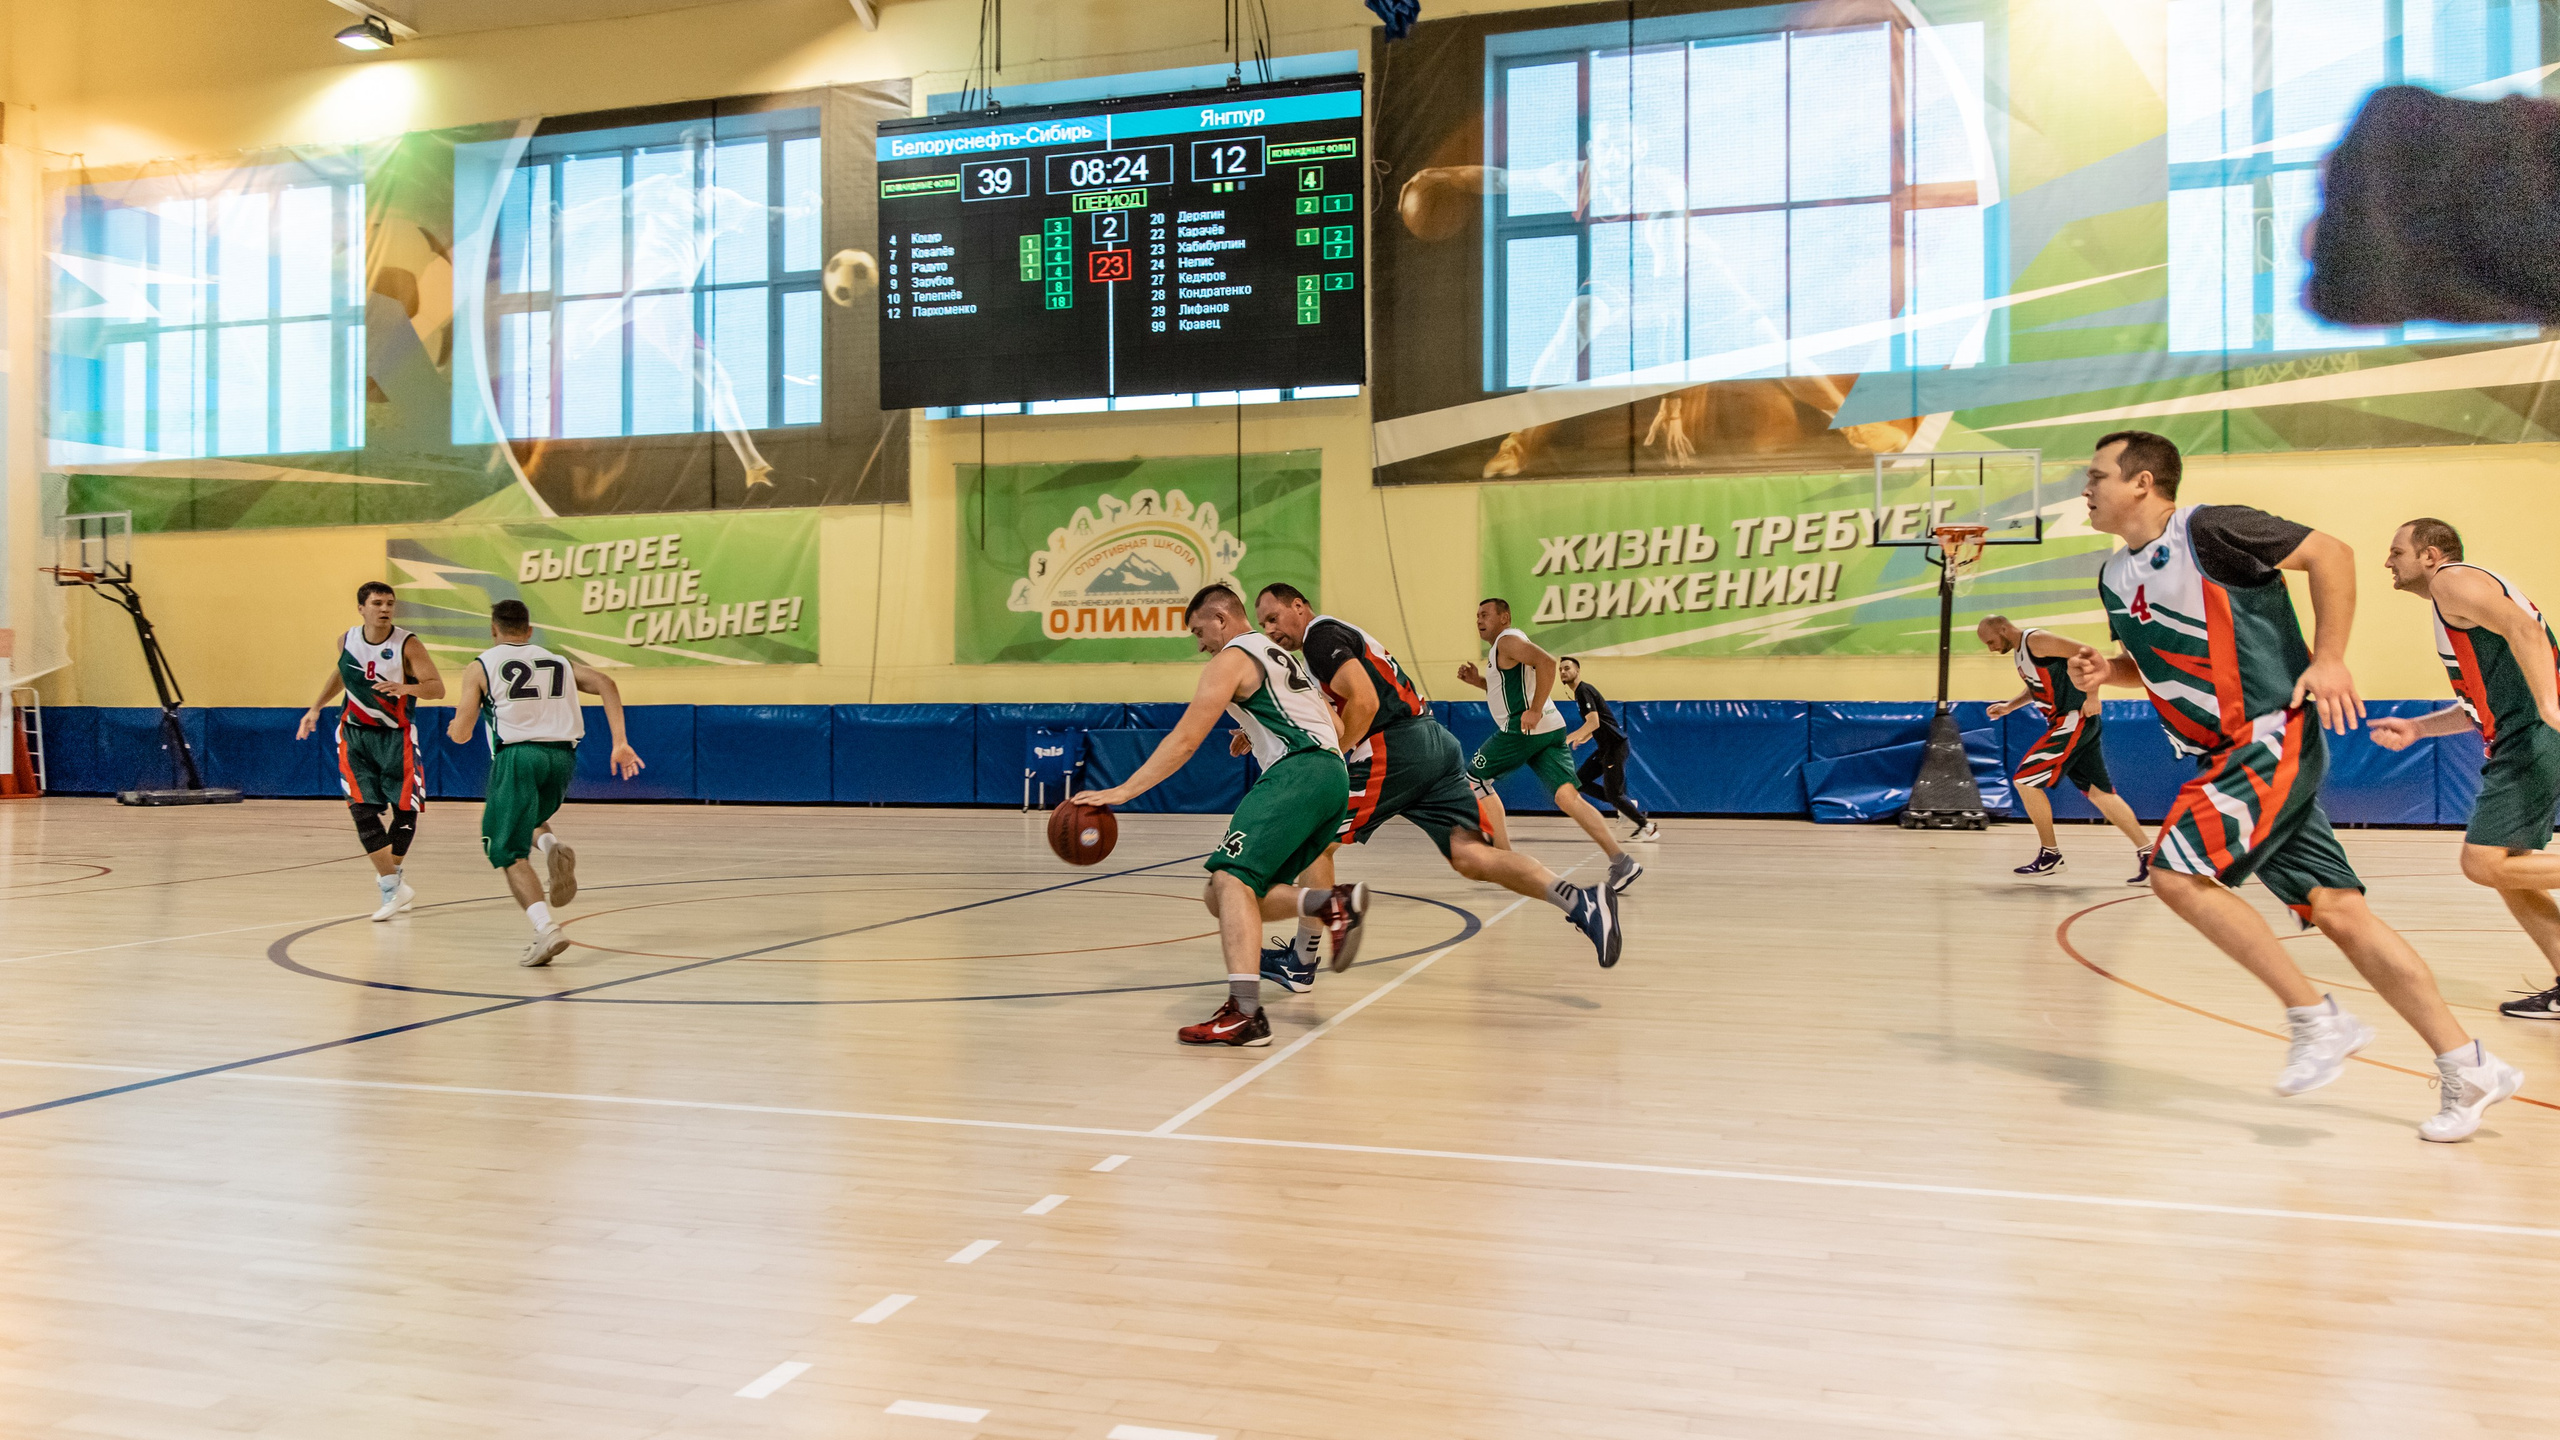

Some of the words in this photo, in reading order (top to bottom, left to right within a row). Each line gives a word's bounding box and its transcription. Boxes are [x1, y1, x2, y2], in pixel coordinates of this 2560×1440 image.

[1200, 107, 1265, 129] Янгпур
[891, 126, 1093, 158] Белоруснефть-Сибирь
[1210, 147, 1247, 175] 12
[1070, 154, 1150, 187] 08:24
[976, 167, 1012, 196] 39
[1304, 171, 1317, 188] 4
[1078, 192, 1141, 211] ПЕРИОД
[1304, 201, 1312, 212] 2
[1334, 199, 1340, 210] 1
[1150, 214, 1165, 225] 20
[1177, 210, 1225, 223] Дерягин
[1054, 222, 1062, 232] 3
[1103, 217, 1117, 238] 2
[1177, 224, 1225, 238] Карачёв
[1150, 229, 1165, 240] 22
[1305, 233, 1310, 243] 1
[1334, 230, 1342, 241] 2
[889, 235, 897, 246] 4
[1027, 240, 1033, 249] 1
[1054, 237, 1062, 247] 2
[890, 250, 897, 260] 7
[1150, 244, 1165, 255] 23
[1027, 254, 1033, 264] 1
[1054, 252, 1062, 262] 4
[890, 265, 897, 275] 8
[1096, 257, 1124, 277] 23
[1150, 260, 1165, 270] 24
[1028, 269, 1033, 279] 1
[1054, 267, 1062, 278] 4
[1178, 272, 1226, 284] Кедяров
[890, 280, 898, 289] 9
[1151, 274, 1165, 286] 27
[1305, 279, 1312, 290] 2
[1335, 278, 1343, 288] 2
[1055, 282, 1062, 292] 8
[1179, 285, 1252, 299] Кондратенко
[888, 294, 901, 304] 10
[912, 289, 962, 302] Телепнёв
[1151, 290, 1166, 301] 28
[1305, 296, 1312, 306] 4
[1052, 297, 1066, 307] 18
[888, 309, 901, 319] 12
[912, 305, 977, 317] Пархоменко
[1151, 306, 1166, 317] 29
[1178, 302, 1229, 316] Лифанов
[1305, 311, 1311, 322] 1
[1151, 321, 1166, 332] 99
[1179, 319, 1221, 331] Кравец
[1532, 523, 1718, 576] ЖИЗНЬ
[1731, 499, 1955, 560] ТРЕБУЕТ
[518, 534, 690, 583] БЫСТРЕЕ,
[1074, 538, 1149, 577] СПОРТИВНАЯ
[1154, 541, 1196, 568] ШКОЛА
[581, 569, 709, 614] ВЫШЕ,
[1532, 561, 1843, 624] ДВИЖЕНИЯ!
[2130, 584, 2153, 624] 4
[625, 596, 804, 647] СИЛЬНЕЕ!
[1050, 606, 1187, 633] ОЛИМП
[366, 660, 376, 680] 8
[1264, 645, 1314, 692] 2
[500, 658, 568, 702] 27
